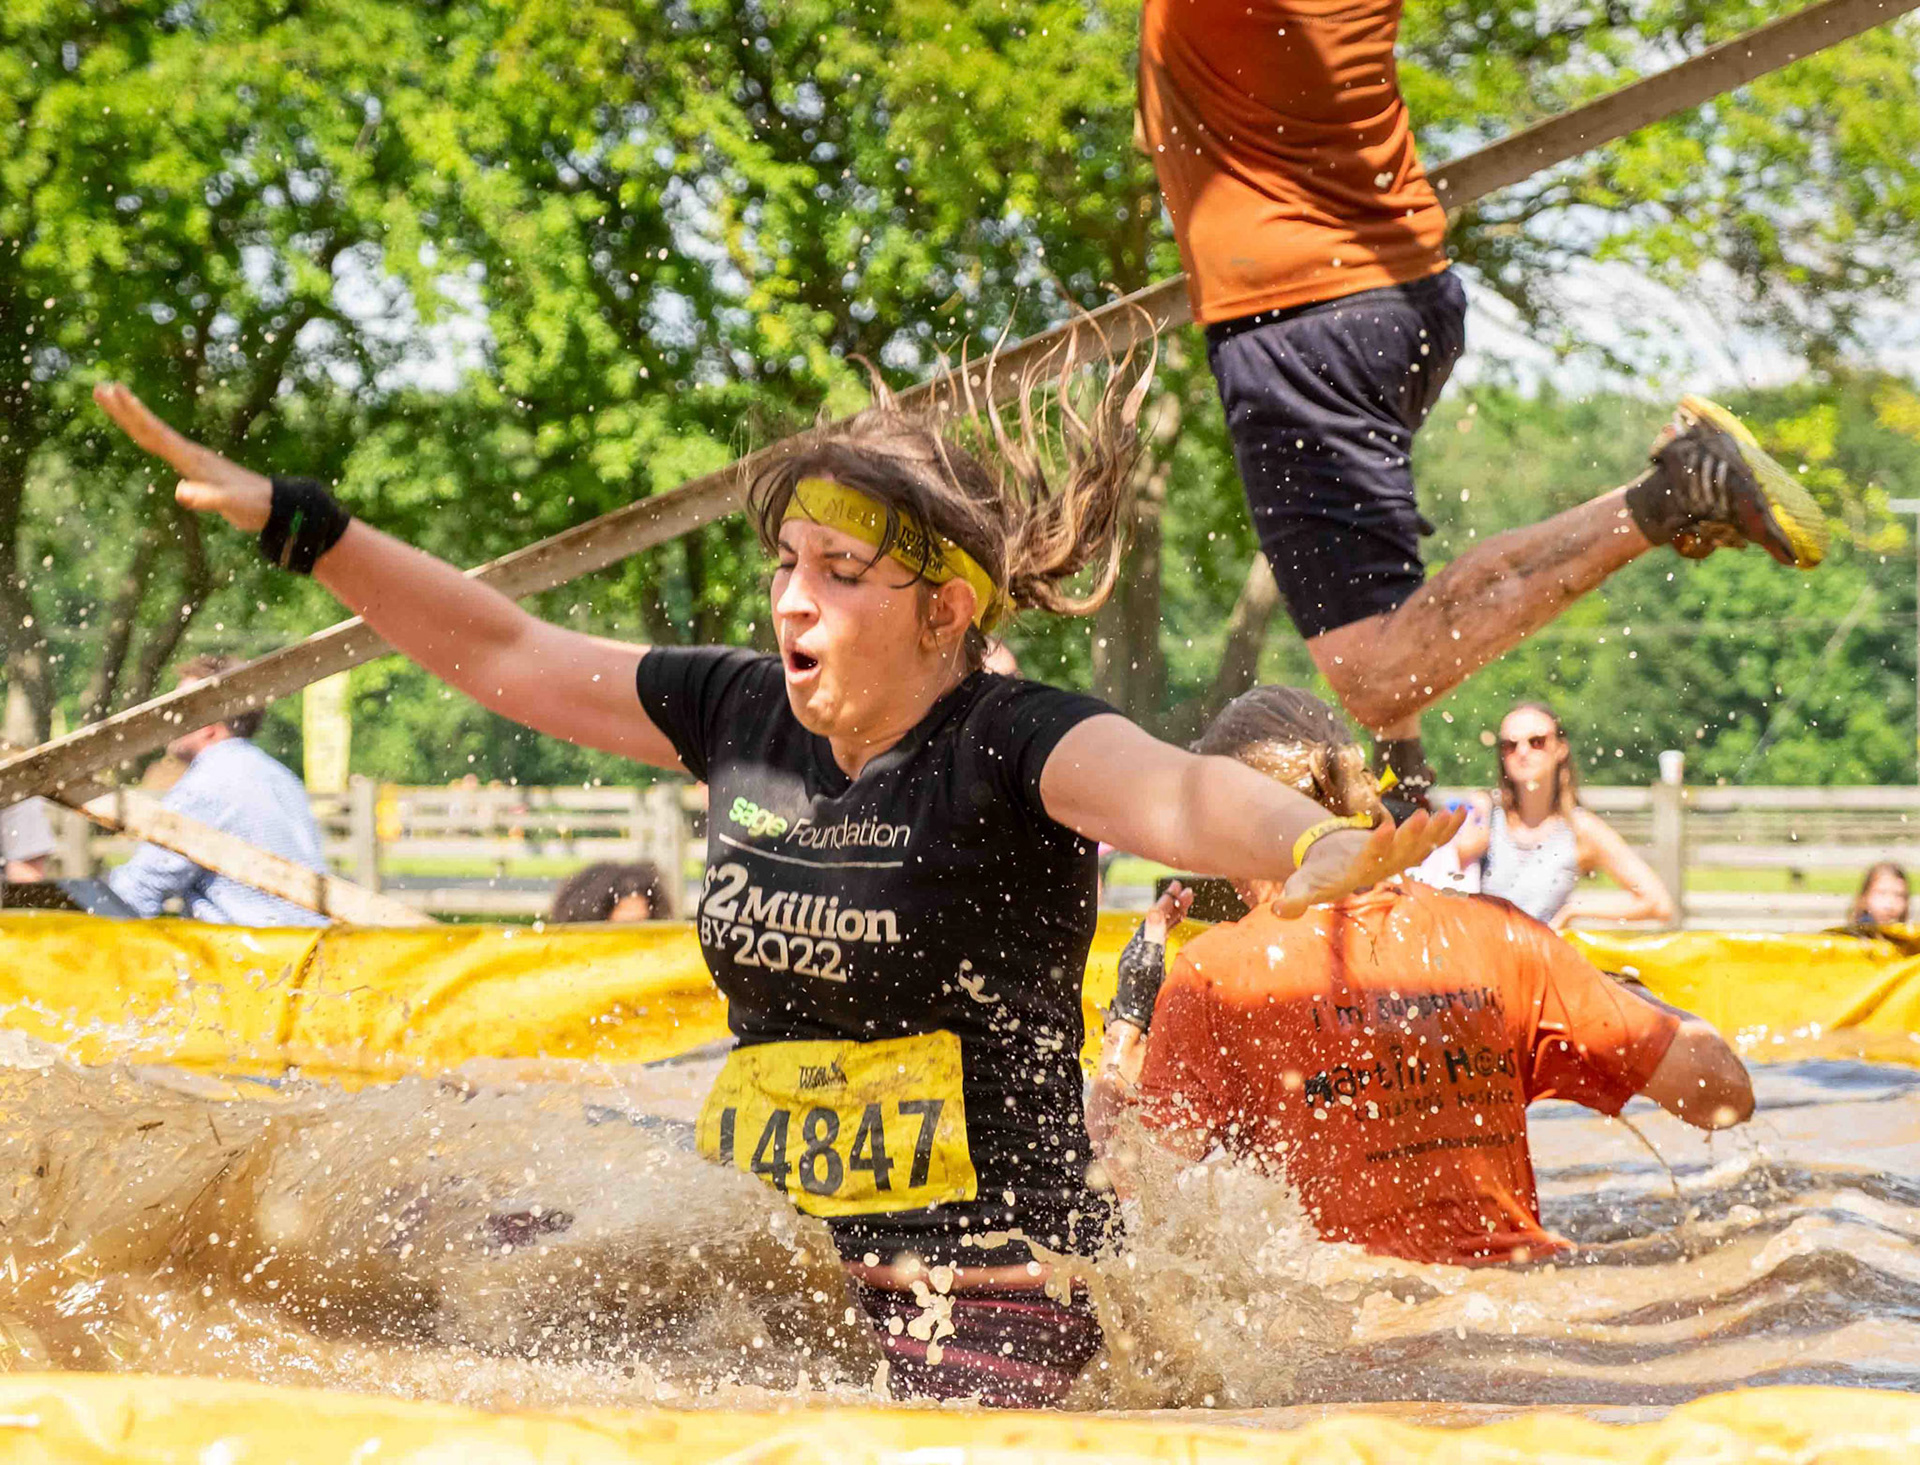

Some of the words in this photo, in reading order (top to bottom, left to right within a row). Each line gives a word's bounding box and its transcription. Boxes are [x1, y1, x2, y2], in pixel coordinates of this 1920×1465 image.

[729, 796, 788, 838] sage
[785, 814, 911, 850] Foundation
[738, 885, 902, 943] Million
[700, 915, 731, 951] BY
[730, 926, 848, 984] 2022
[1444, 1046, 1516, 1084] Hous
[719, 1098, 946, 1196] 14847
